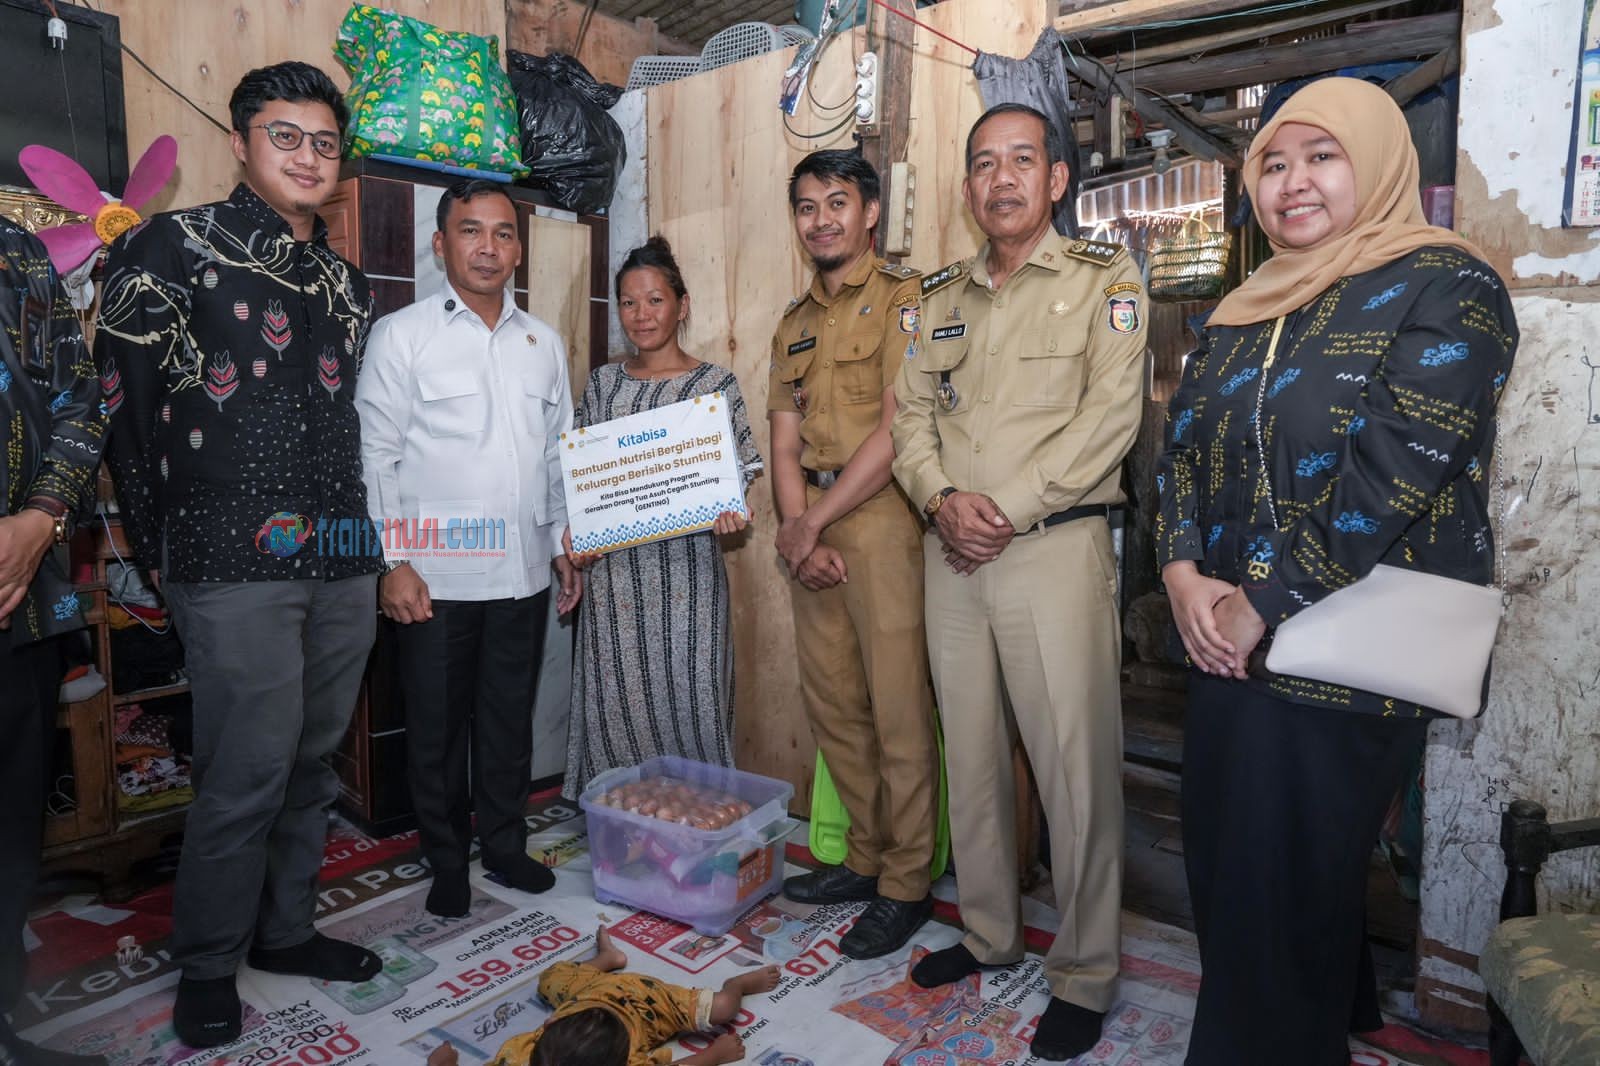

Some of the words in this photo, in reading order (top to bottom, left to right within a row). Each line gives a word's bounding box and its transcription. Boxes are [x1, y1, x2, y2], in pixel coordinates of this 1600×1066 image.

[618, 427, 667, 448] Kitabisa
[571, 460, 618, 478] Bantuan
[620, 450, 655, 466] Nutrisi
[658, 438, 695, 456] Bergizi
[696, 431, 722, 446] bagi
[576, 475, 626, 493] Keluarga
[628, 462, 672, 480] Berisiko
[673, 450, 722, 468] Stunting
[584, 502, 613, 514] Gerakan
[614, 497, 635, 510] Orang
[636, 494, 648, 502] Tua
[649, 489, 666, 499] Asuh
[667, 484, 689, 497] Cegah
[690, 476, 720, 491] Stunting
[600, 491, 614, 501] Kita
[615, 488, 629, 498] Bisa
[630, 478, 669, 496] Mendukung
[670, 472, 699, 486] Program
[635, 498, 670, 512] (GENTING)
[456, 938, 505, 962] Chingku
[506, 914, 556, 940] Sparkling
[472, 924, 514, 946] ADEM
[512, 911, 544, 930] SARI
[526, 920, 561, 938] 320ml
[785, 916, 861, 976] 677
[436, 926, 580, 998] 159.600
[988, 972, 1010, 987] POP
[265, 1000, 313, 1022] OKKY
[272, 1008, 319, 1026] Varian
[964, 1002, 1000, 1027] Goreng
